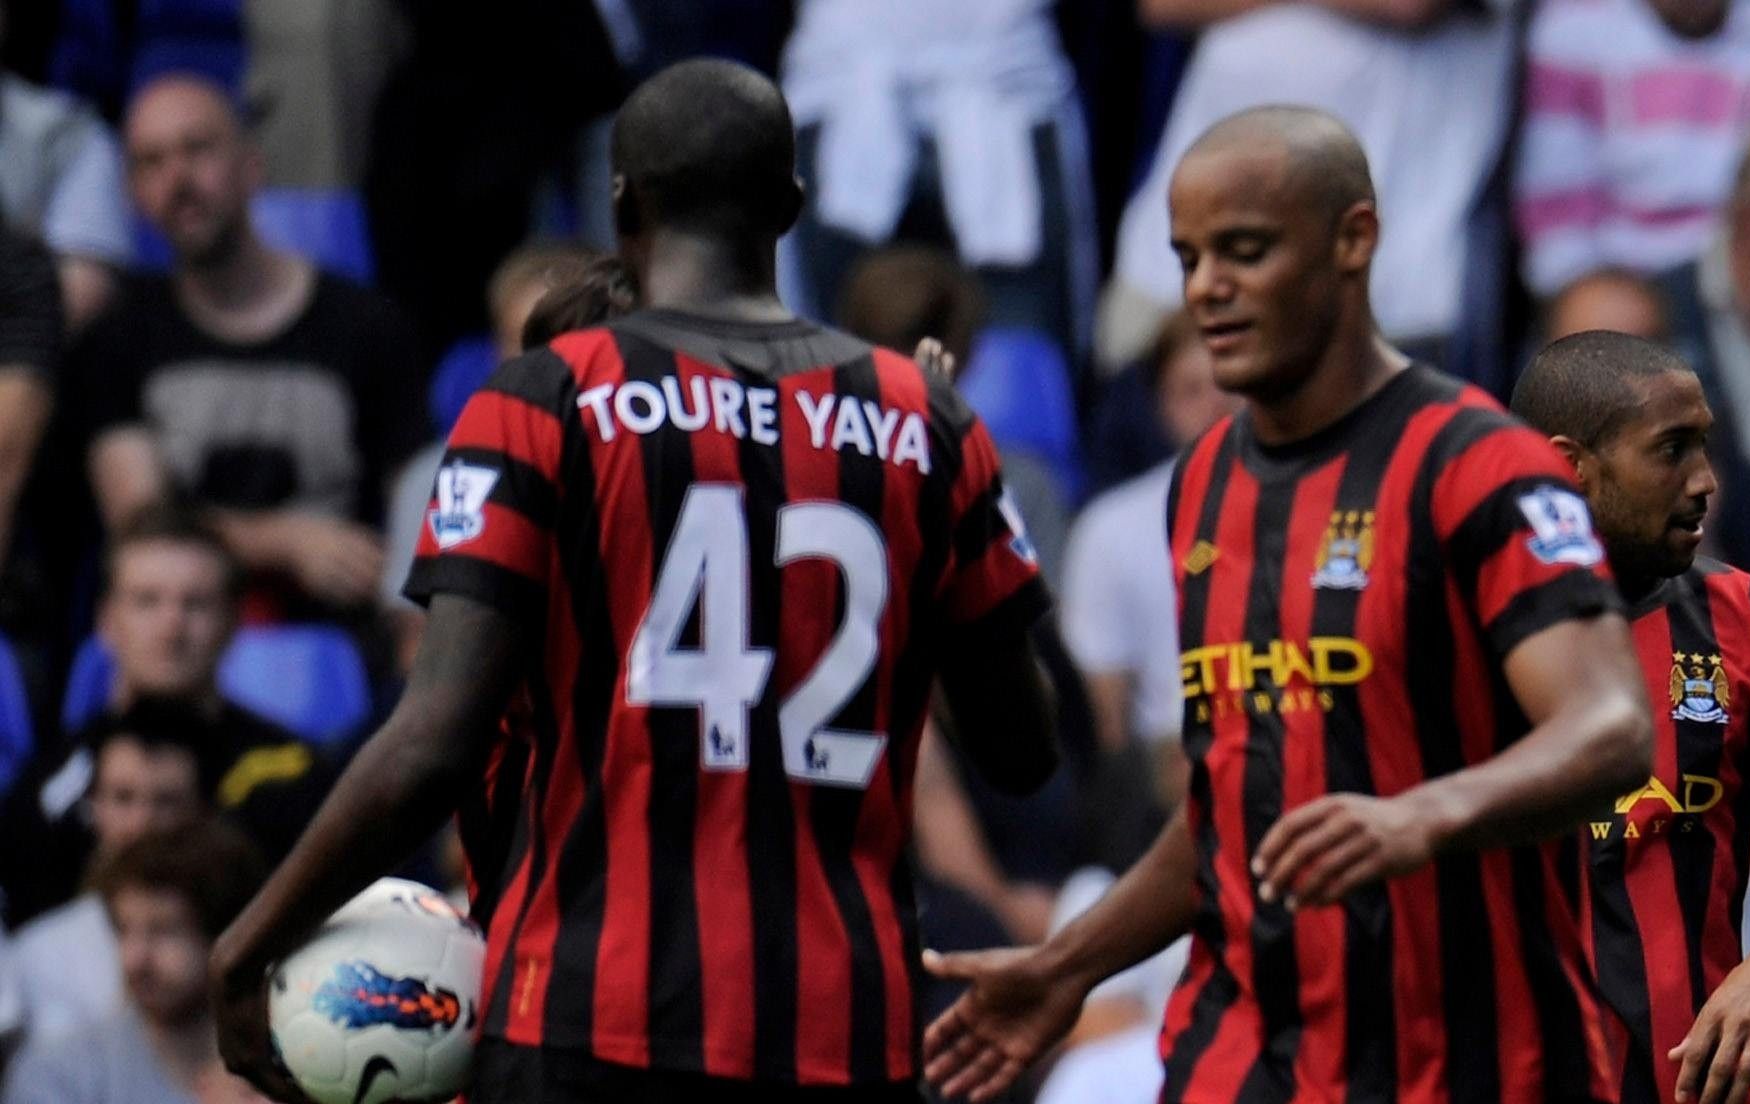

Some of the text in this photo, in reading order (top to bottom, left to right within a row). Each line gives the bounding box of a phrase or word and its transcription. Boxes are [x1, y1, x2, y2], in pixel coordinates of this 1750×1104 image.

[577, 375, 932, 475] TOURE YAYA
[627, 484, 888, 786] 42
[1589, 820, 1695, 840] WAYS
